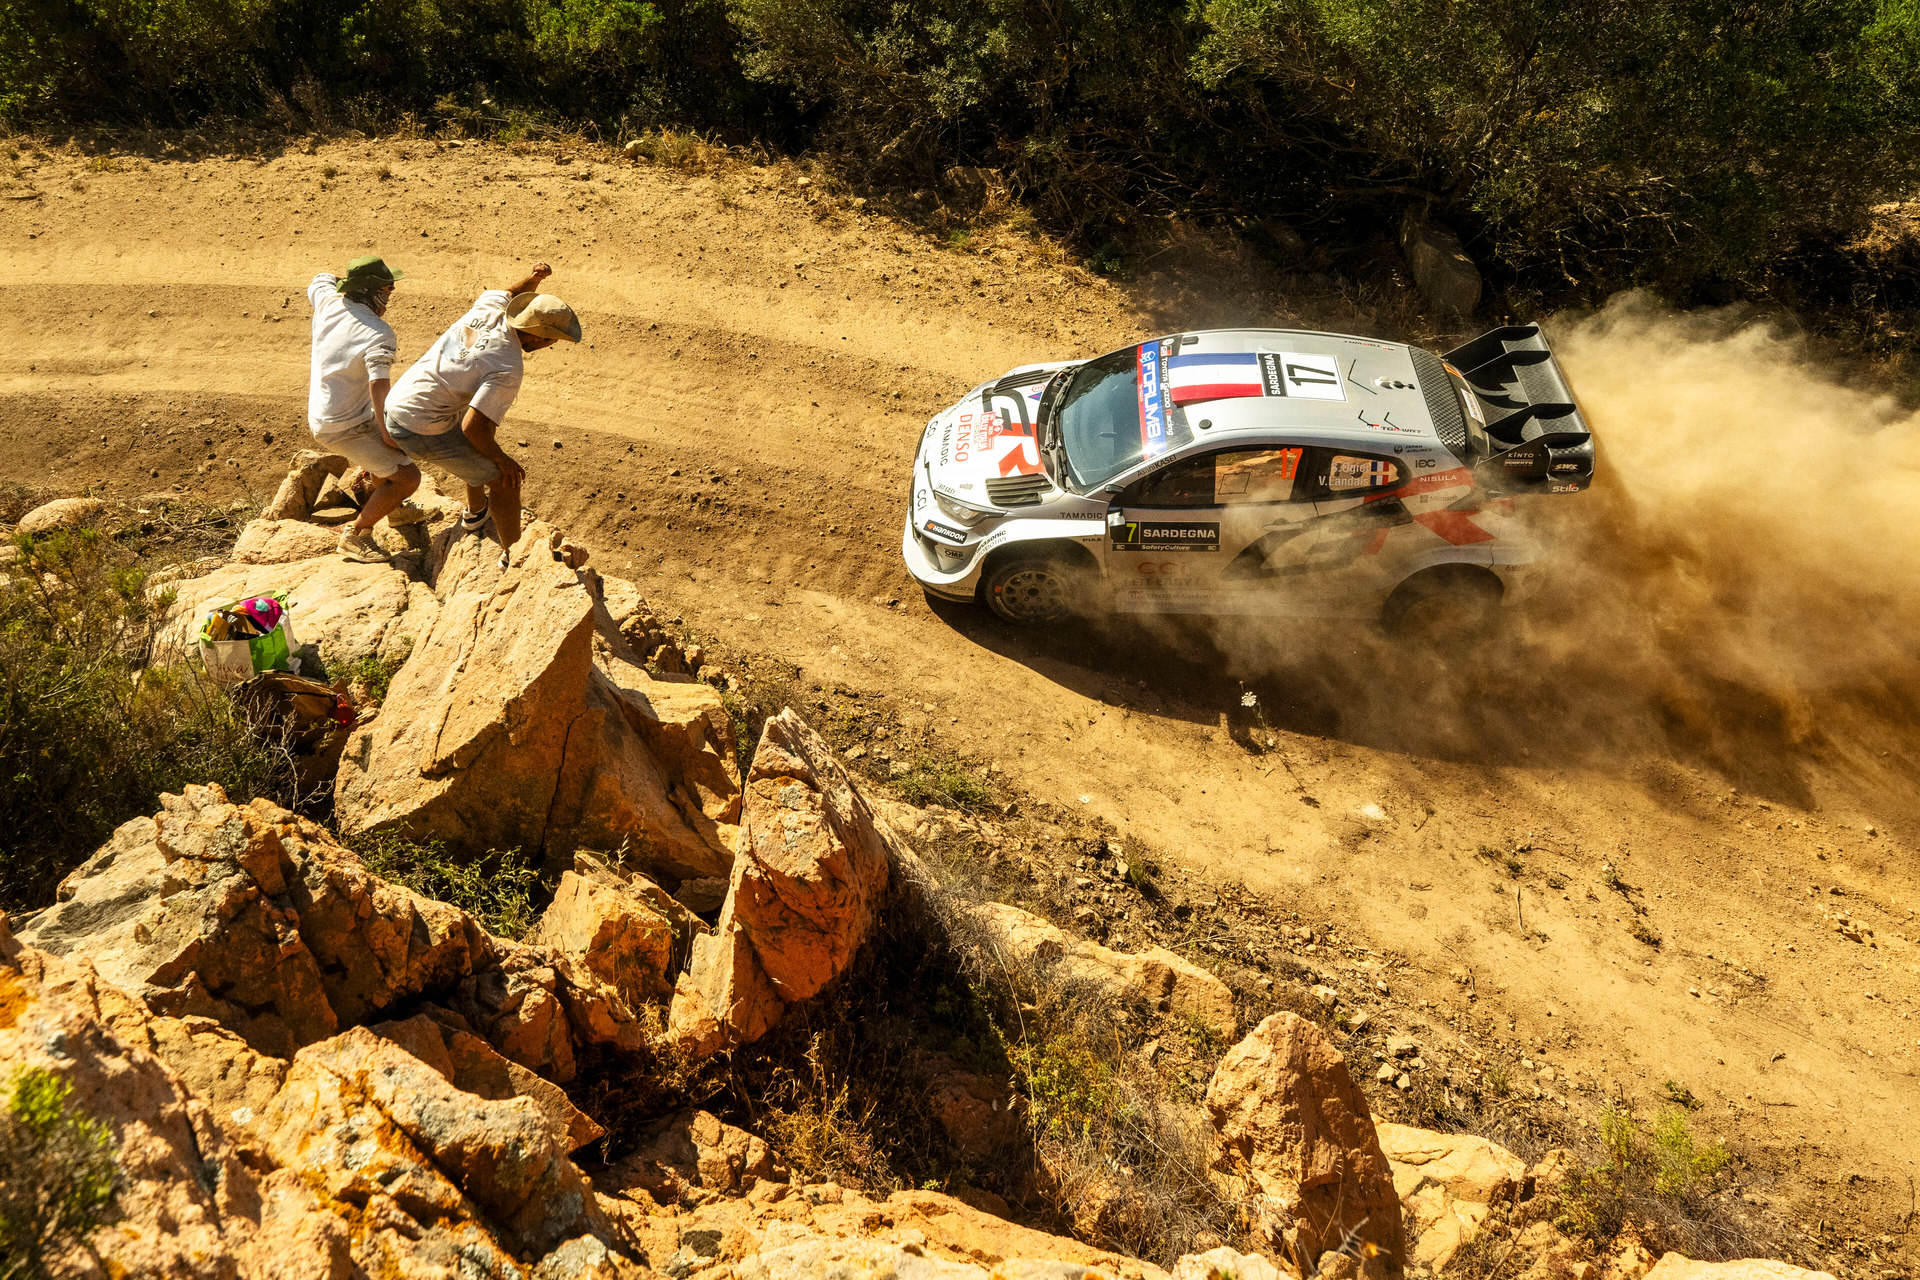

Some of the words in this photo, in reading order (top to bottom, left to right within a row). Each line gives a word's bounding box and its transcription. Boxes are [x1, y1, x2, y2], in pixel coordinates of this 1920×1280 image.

[1266, 353, 1281, 396] SARDEGNA
[1286, 363, 1338, 387] 17
[1143, 361, 1161, 439] FORUM8
[940, 423, 952, 466] TAMADIC
[955, 413, 973, 462] DENSO
[1280, 448, 1303, 480] 17
[1420, 474, 1457, 483] NISULA
[1552, 483, 1579, 493] Stilo
[1143, 529, 1216, 538] SARDEGNA
